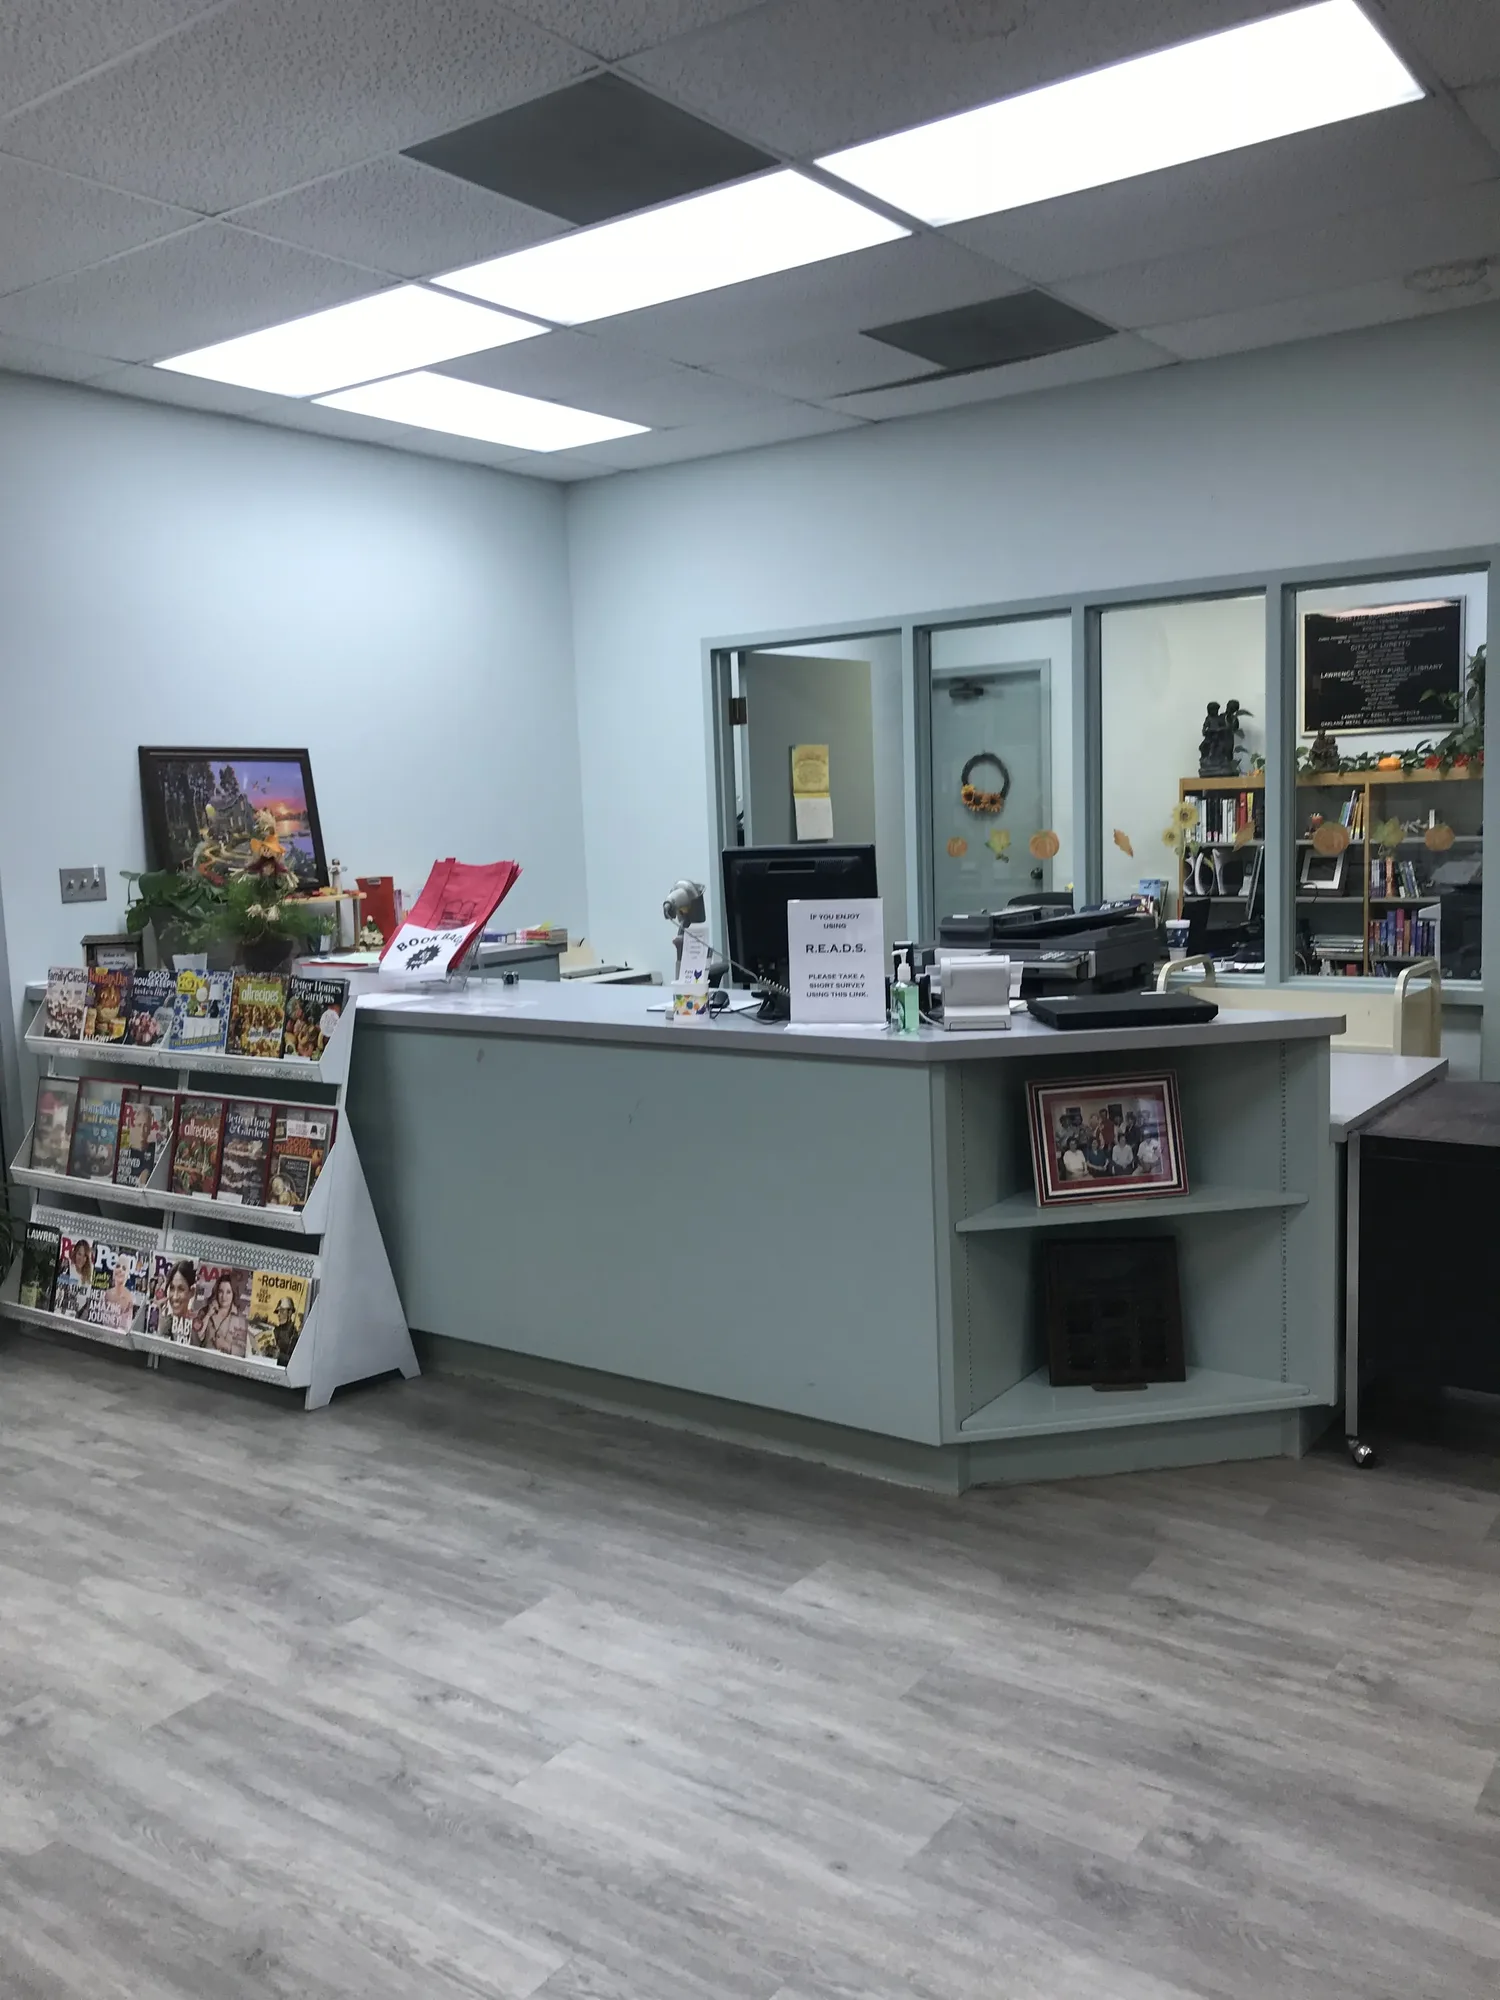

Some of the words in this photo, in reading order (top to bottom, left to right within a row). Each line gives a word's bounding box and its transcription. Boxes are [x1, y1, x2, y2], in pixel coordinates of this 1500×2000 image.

[1320, 669, 1356, 679] LAWRENCE
[1358, 667, 1385, 676] COUNTY
[1414, 663, 1443, 672] LIBRARY
[397, 934, 440, 952] BOOK
[805, 943, 867, 954] R.E.A.D.S.
[133, 977, 177, 989] HOUSEKEEPIN
[148, 970, 171, 980] GOOD
[241, 983, 279, 1003] allrecipes
[291, 977, 312, 991] Better
[313, 978, 342, 994] Homes
[301, 990, 335, 1004] Gardens
[184, 1118, 219, 1141] allrecipes
[261, 1274, 302, 1293] Rotarian
[90, 1289, 106, 1300] HER
